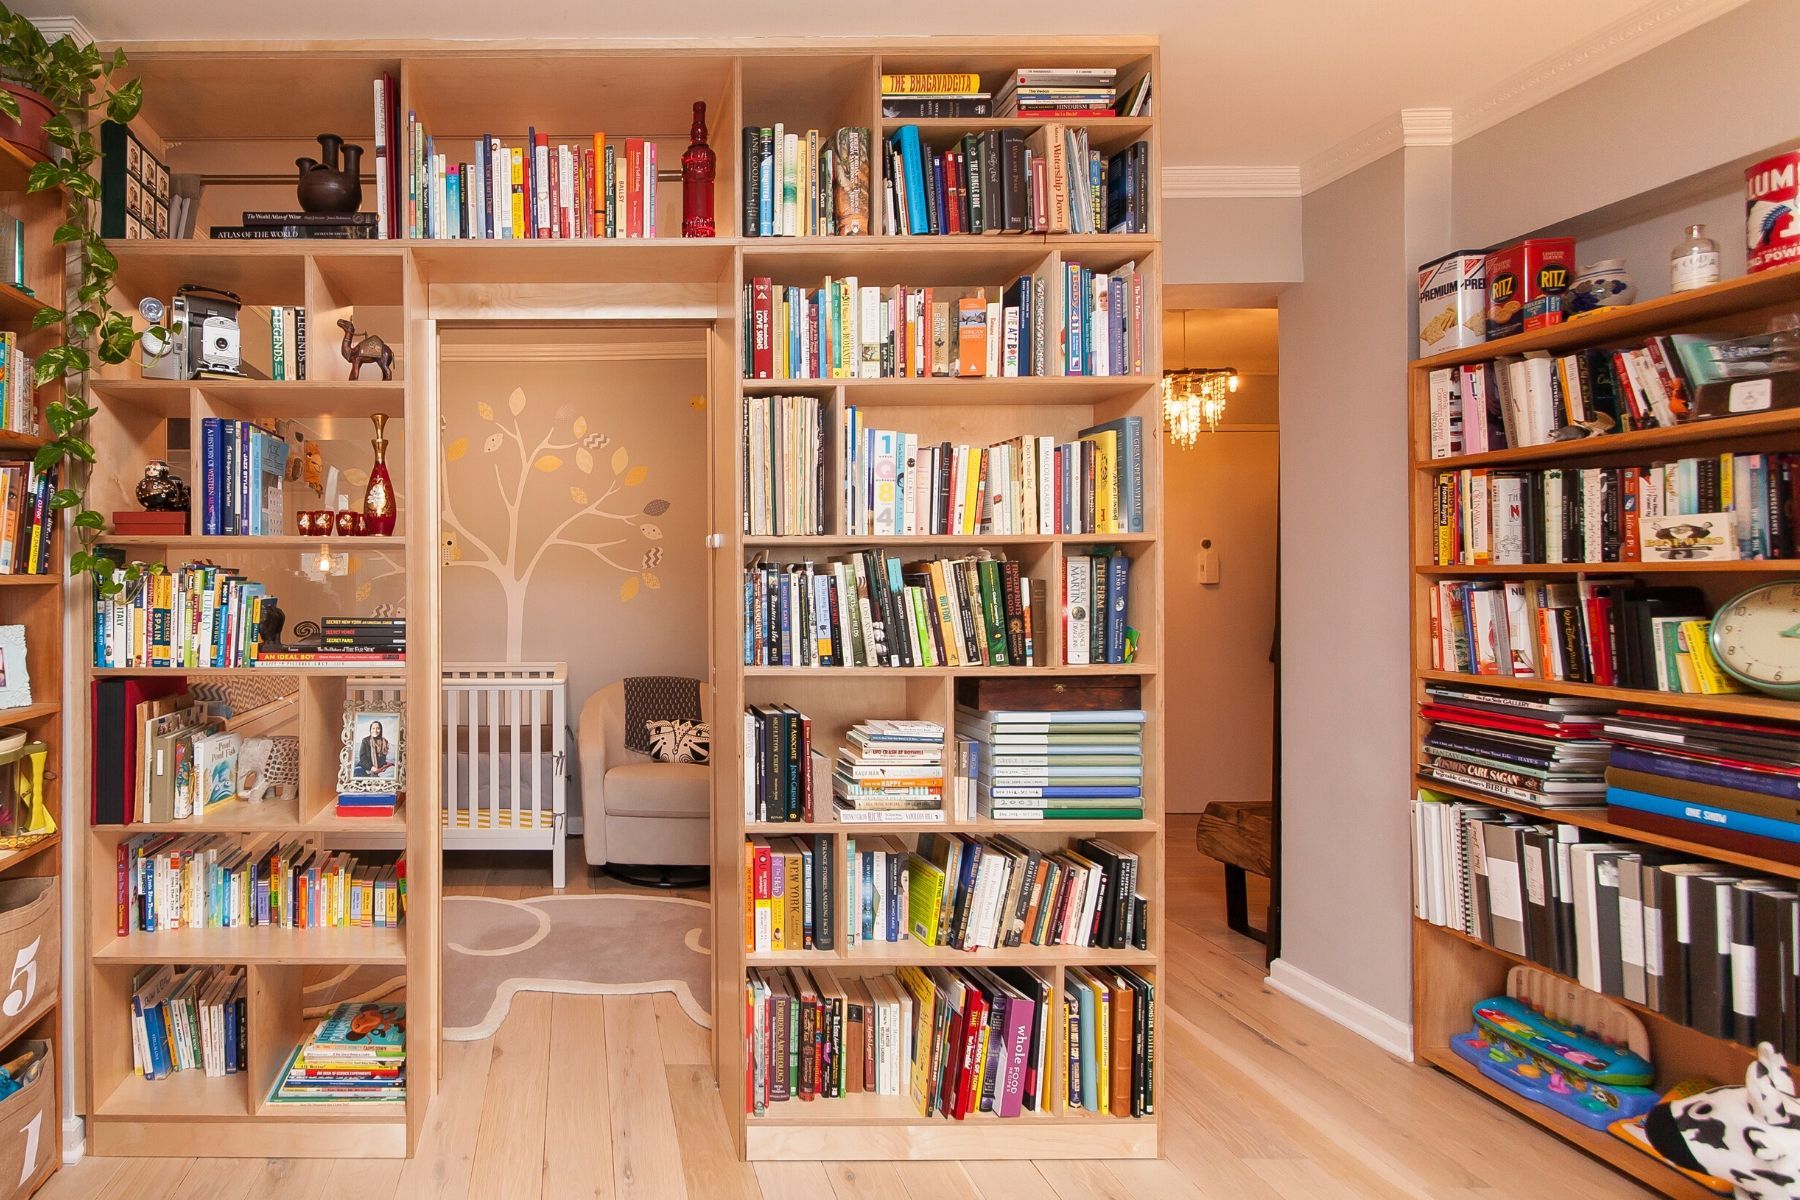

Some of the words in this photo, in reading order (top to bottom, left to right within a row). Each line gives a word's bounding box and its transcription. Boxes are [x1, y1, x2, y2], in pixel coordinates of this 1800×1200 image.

[890, 75, 906, 92] THE
[1053, 144, 1063, 191] Watership
[971, 173, 979, 192] JUNGLE
[1056, 193, 1064, 223] Down
[1420, 279, 1458, 303] PREMIUM
[1464, 278, 1486, 290] PRE
[1492, 277, 1513, 300] RITZ
[1541, 270, 1567, 288] RITZ
[273, 316, 283, 361] LEGENDS
[1473, 489, 1481, 526] OKINAWA
[1005, 564, 1012, 575] OF
[1097, 563, 1105, 584] THE
[1071, 565, 1080, 604] MARTIN
[1097, 585, 1105, 608] FIRM
[204, 594, 212, 633] TURKEY
[1725, 626, 1733, 634] 9
[1728, 646, 1736, 655] 8
[1746, 663, 1752, 673] 7
[1774, 671, 1782, 680] 6
[1468, 765, 1490, 776] CARL
[1490, 771, 1520, 785] SAGAN
[1485, 782, 1511, 794] BIBLE
[789, 859, 799, 883] NEW
[1023, 861, 1035, 896] ROBINSON
[773, 876, 783, 893] Help
[790, 886, 799, 913] YORK
[3, 935, 41, 1017] 5
[777, 1000, 785, 1038] FORBIDDEN
[1014, 1025, 1027, 1064] whole
[777, 1040, 785, 1083] ARCHEOLOGY
[1010, 1067, 1020, 1094] FOOD
[18, 1109, 42, 1189] 1
